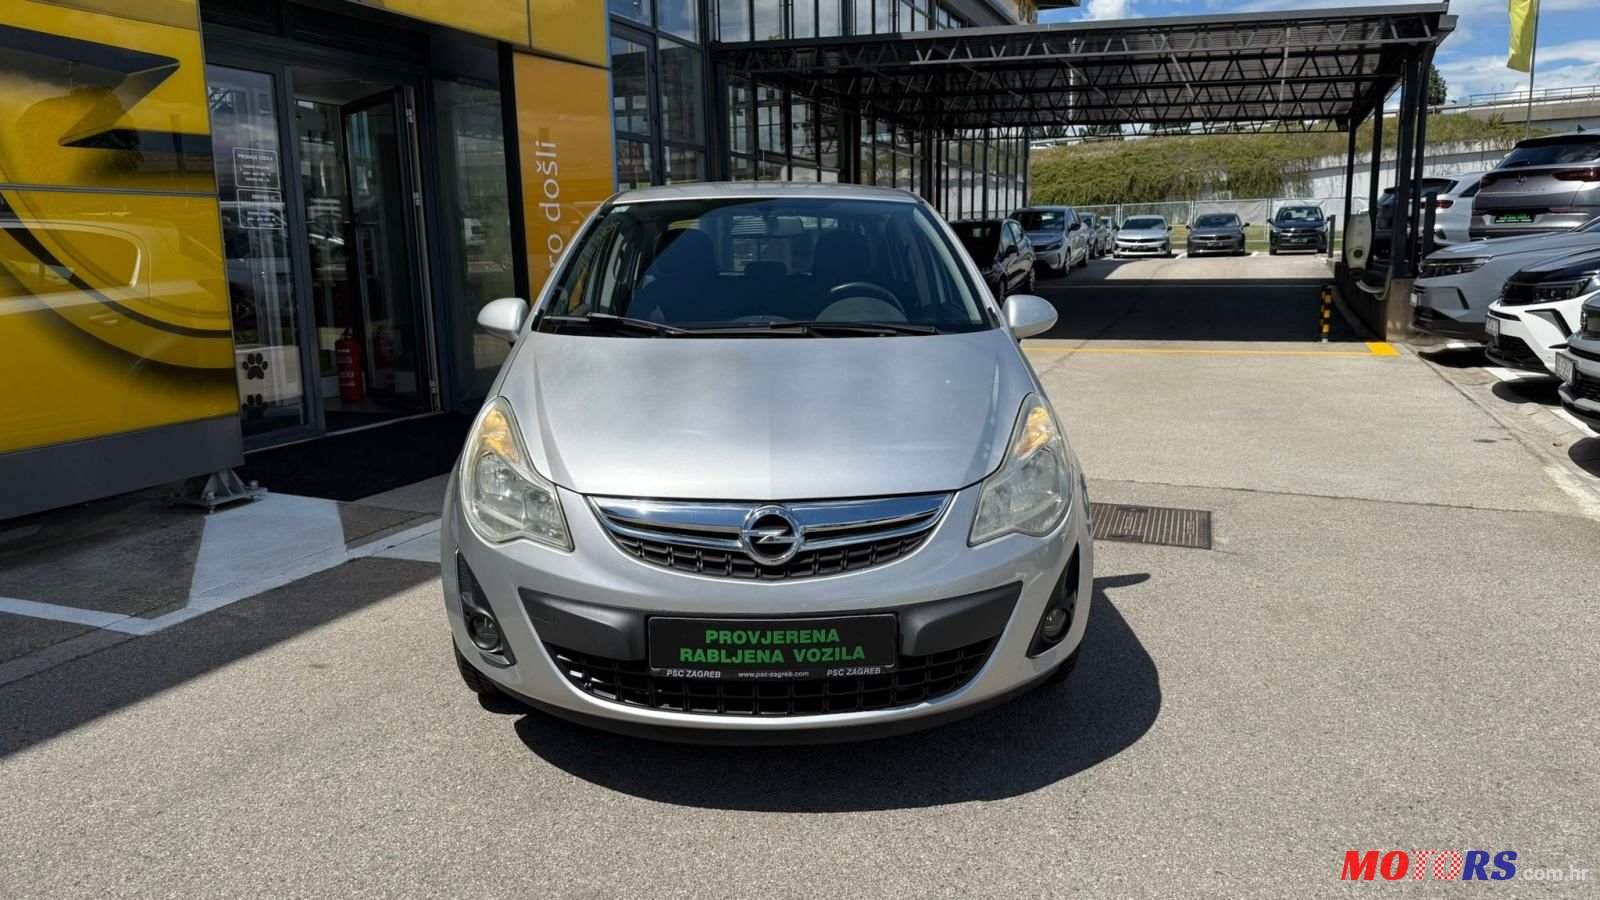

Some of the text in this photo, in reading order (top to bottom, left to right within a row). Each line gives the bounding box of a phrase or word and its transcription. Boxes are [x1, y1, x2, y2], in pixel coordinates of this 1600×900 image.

[535, 141, 561, 222] došli
[705, 628, 840, 645] PROVJERENA
[680, 646, 865, 664] RABLJENA VOZILA
[666, 669, 721, 679] PSC ZAGREB
[738, 670, 810, 679] www.psc-zagreb.com
[826, 667, 881, 677] PSC ZAGREB
